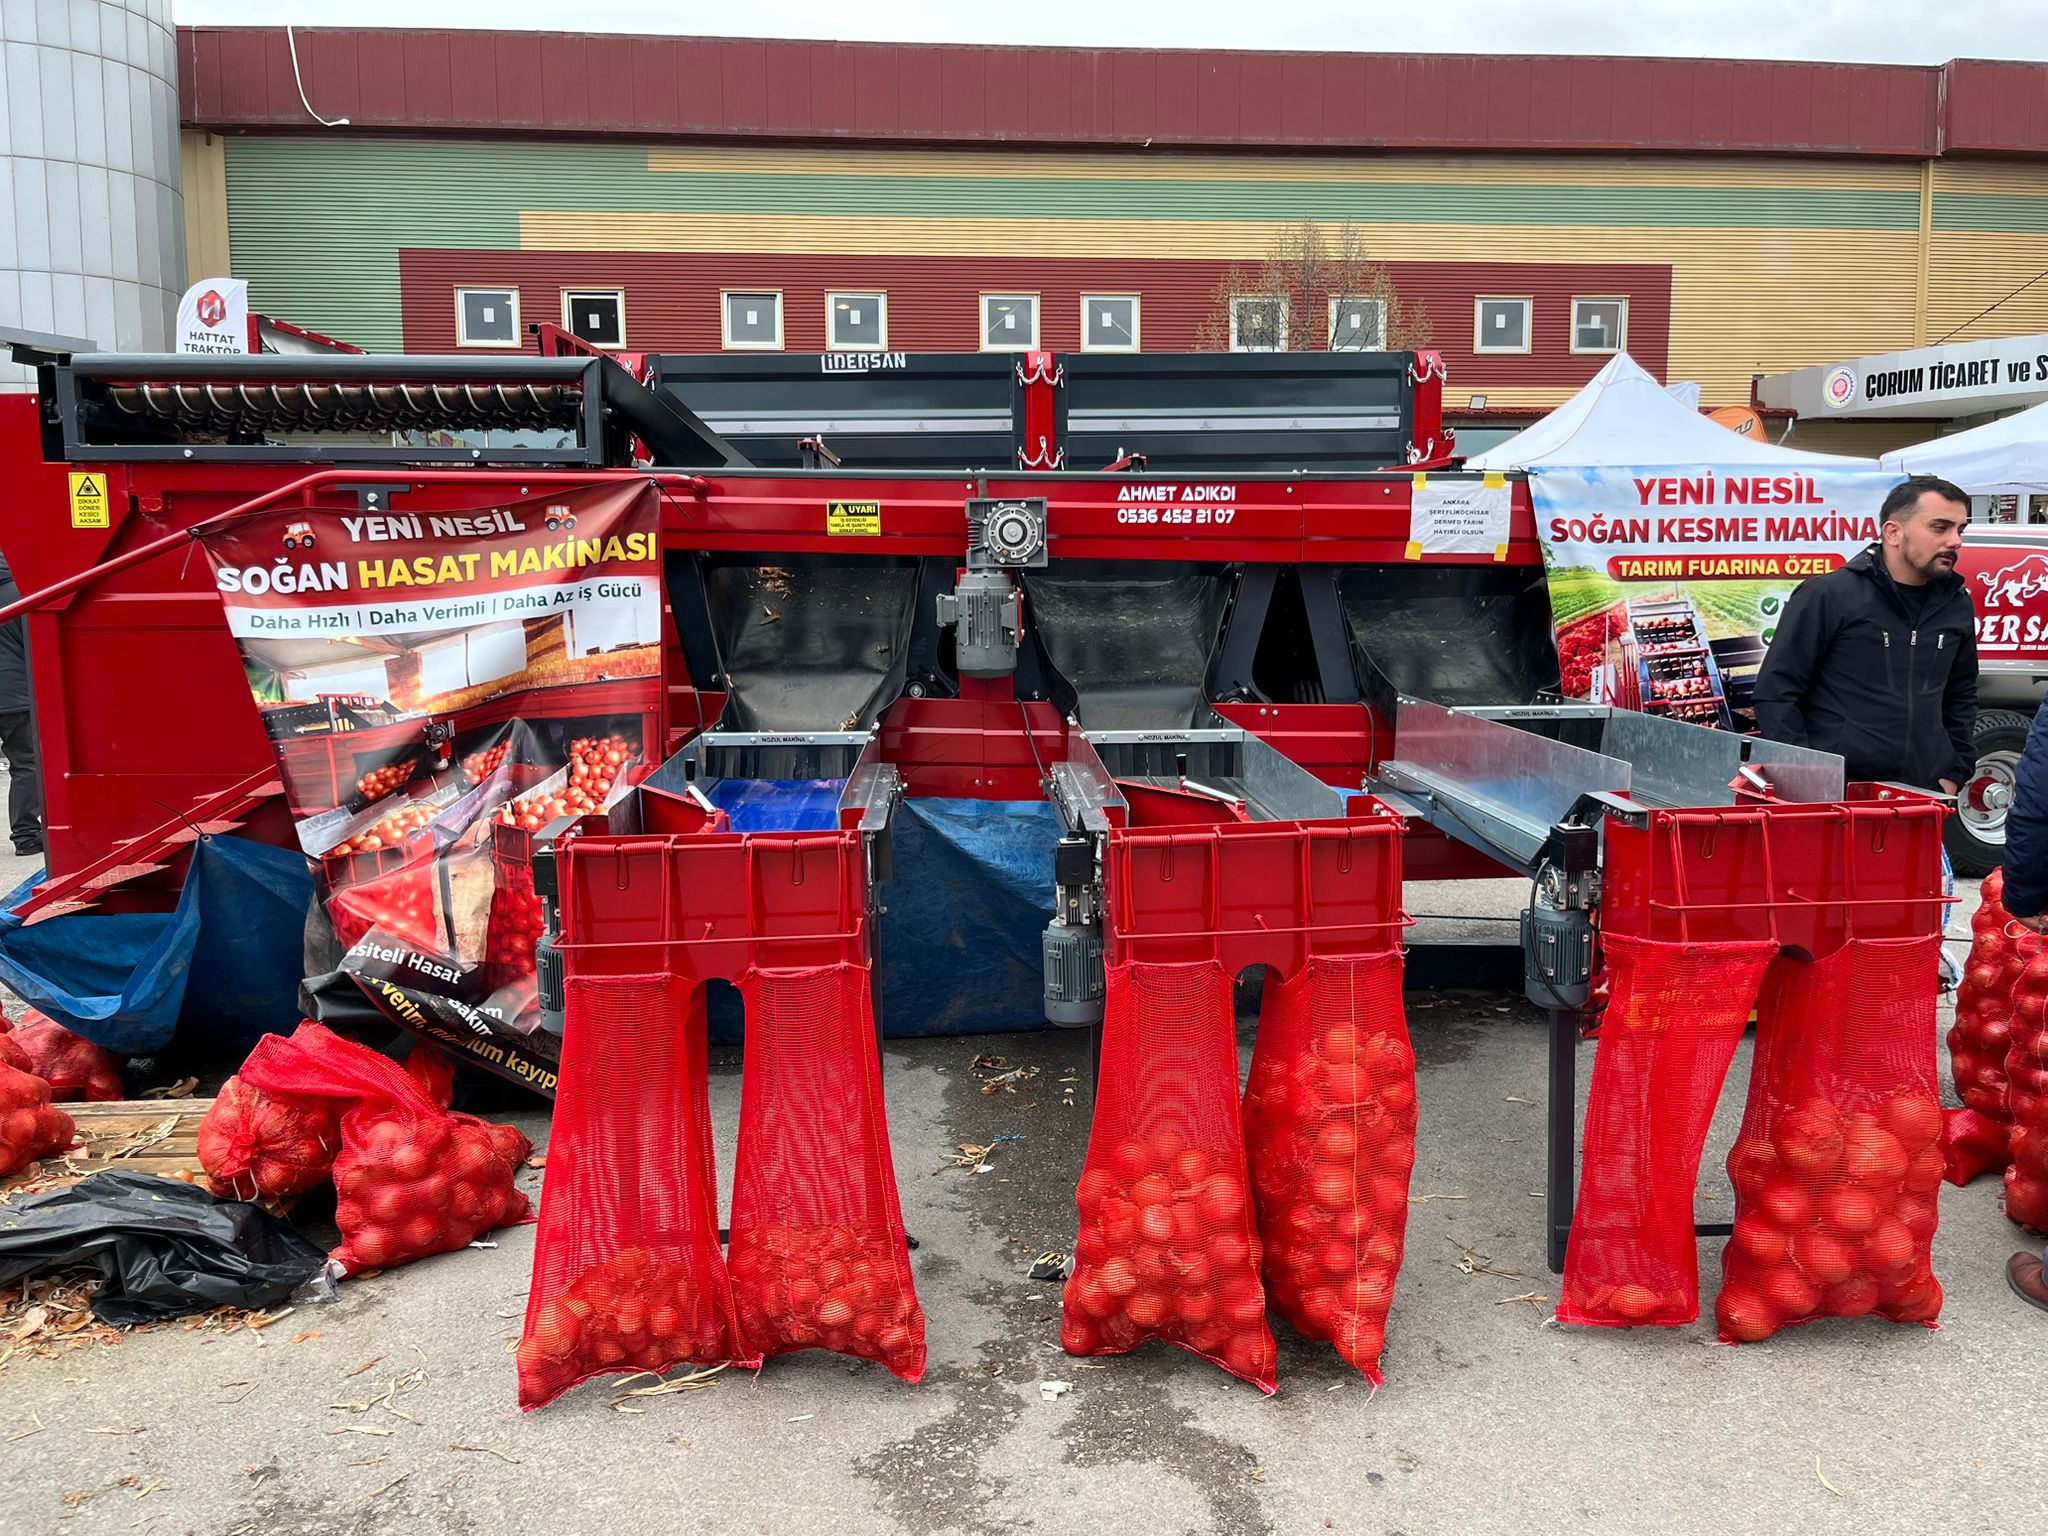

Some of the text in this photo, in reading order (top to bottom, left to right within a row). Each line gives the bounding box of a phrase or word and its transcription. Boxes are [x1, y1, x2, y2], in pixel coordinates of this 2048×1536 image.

[189, 331, 235, 345] HATTAT
[1865, 367, 1923, 401] ÇORUM
[1928, 358, 2000, 391] TİCARET
[2007, 361, 2030, 383] ve
[1117, 486, 1236, 501] AHMET ADIKDI
[1633, 470, 1823, 505] YENİ NESİL
[341, 508, 525, 542] YENİ NESİL
[848, 505, 876, 513] UYARI
[1117, 508, 1236, 523] 0536 452 21 07
[1550, 512, 1648, 544] SOĞAN
[1657, 517, 1758, 543] KESME
[217, 532, 657, 595] SOĞAN HASAT MAKİNASI
[1618, 554, 1834, 577] TARIM FUARINA ÖZEL
[251, 614, 300, 630] Daha
[308, 612, 350, 629] Hızlı
[370, 609, 417, 626] Daha
[422, 601, 485, 621] Verimli
[503, 593, 548, 611] Daha
[553, 591, 574, 606] Az
[598, 583, 641, 598] Gücü
[407, 952, 462, 984] Hasat
